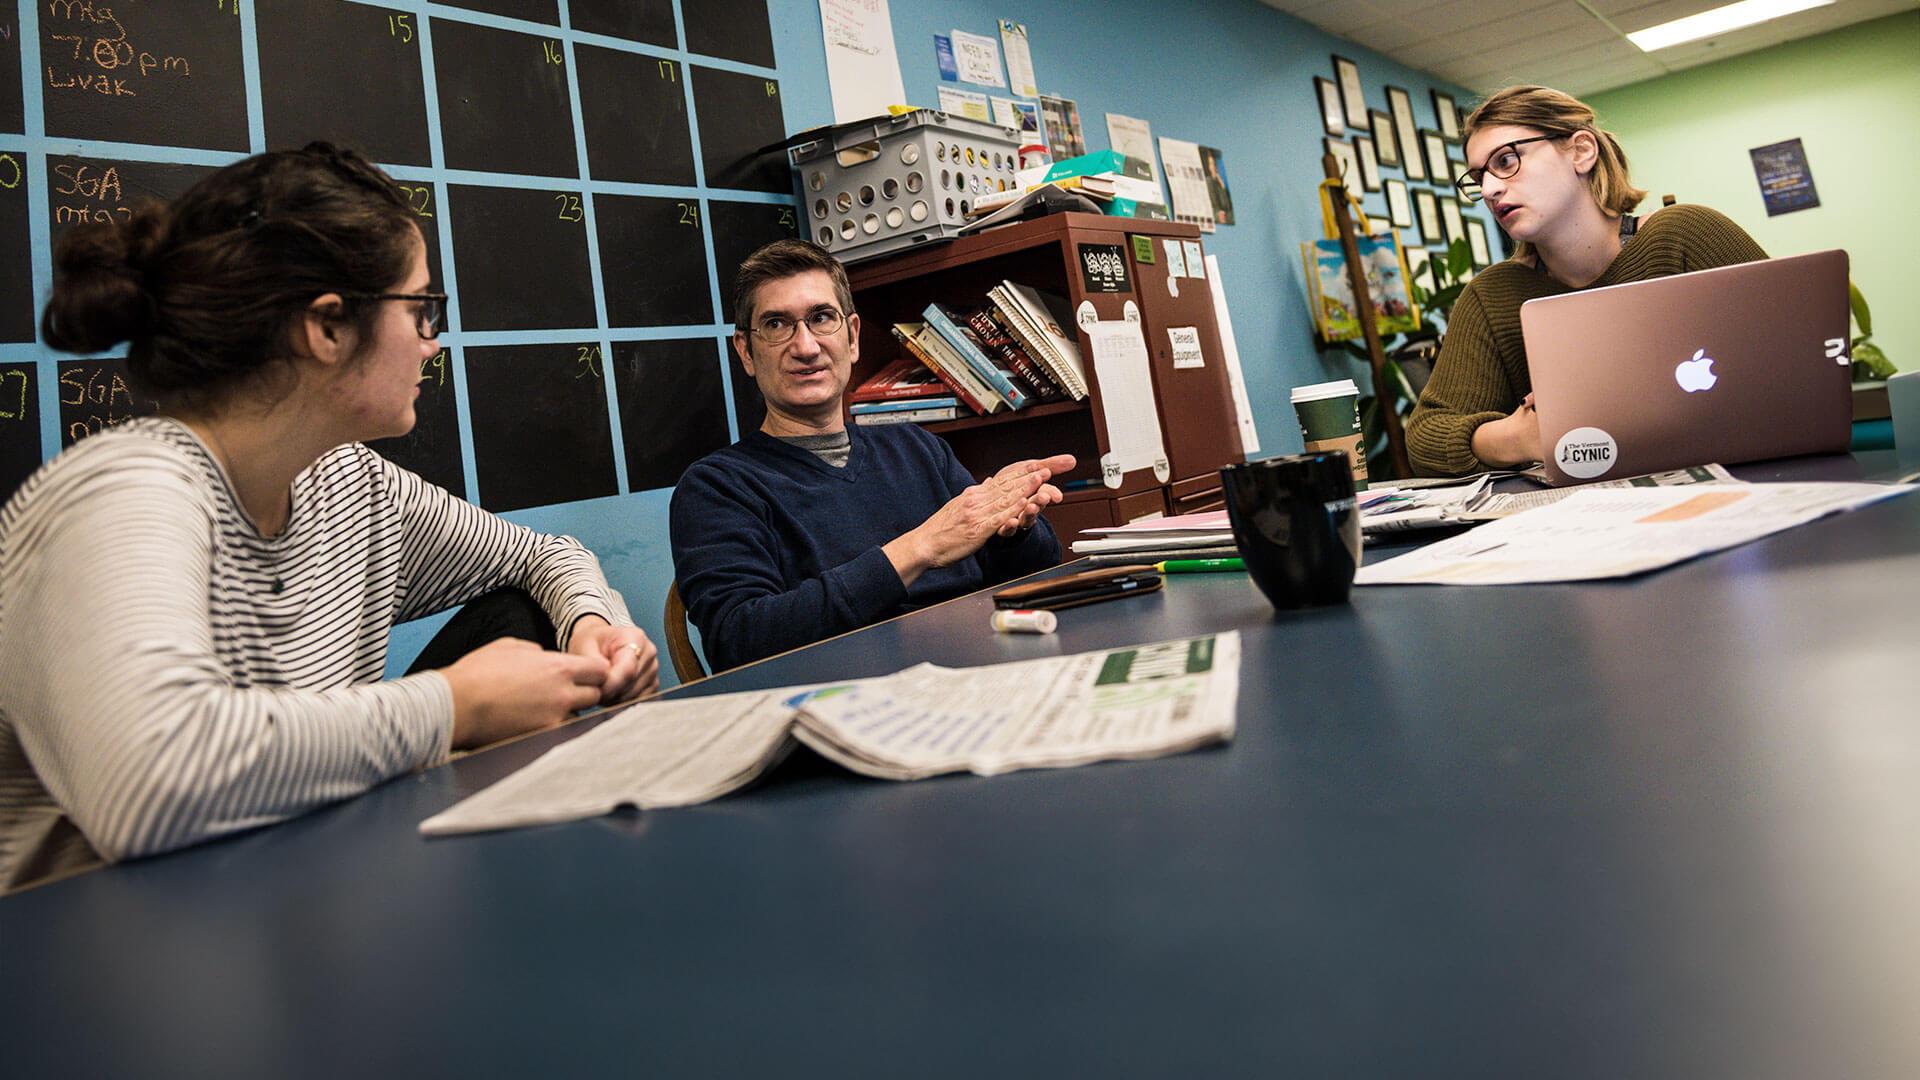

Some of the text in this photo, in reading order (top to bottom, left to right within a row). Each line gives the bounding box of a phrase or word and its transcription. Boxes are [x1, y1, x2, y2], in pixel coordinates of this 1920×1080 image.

[389, 15, 412, 43] 15
[543, 40, 563, 65] 16
[658, 60, 676, 82] 17
[765, 81, 776, 97] 18
[55, 164, 122, 201] SGA
[555, 194, 583, 222] 23
[677, 203, 698, 228] 24
[778, 208, 795, 229] 25
[970, 318, 999, 348] CRONIN
[1002, 346, 1040, 386] THE TWELVE
[60, 367, 134, 406] SGA
[1572, 447, 1610, 462] CYNIC
